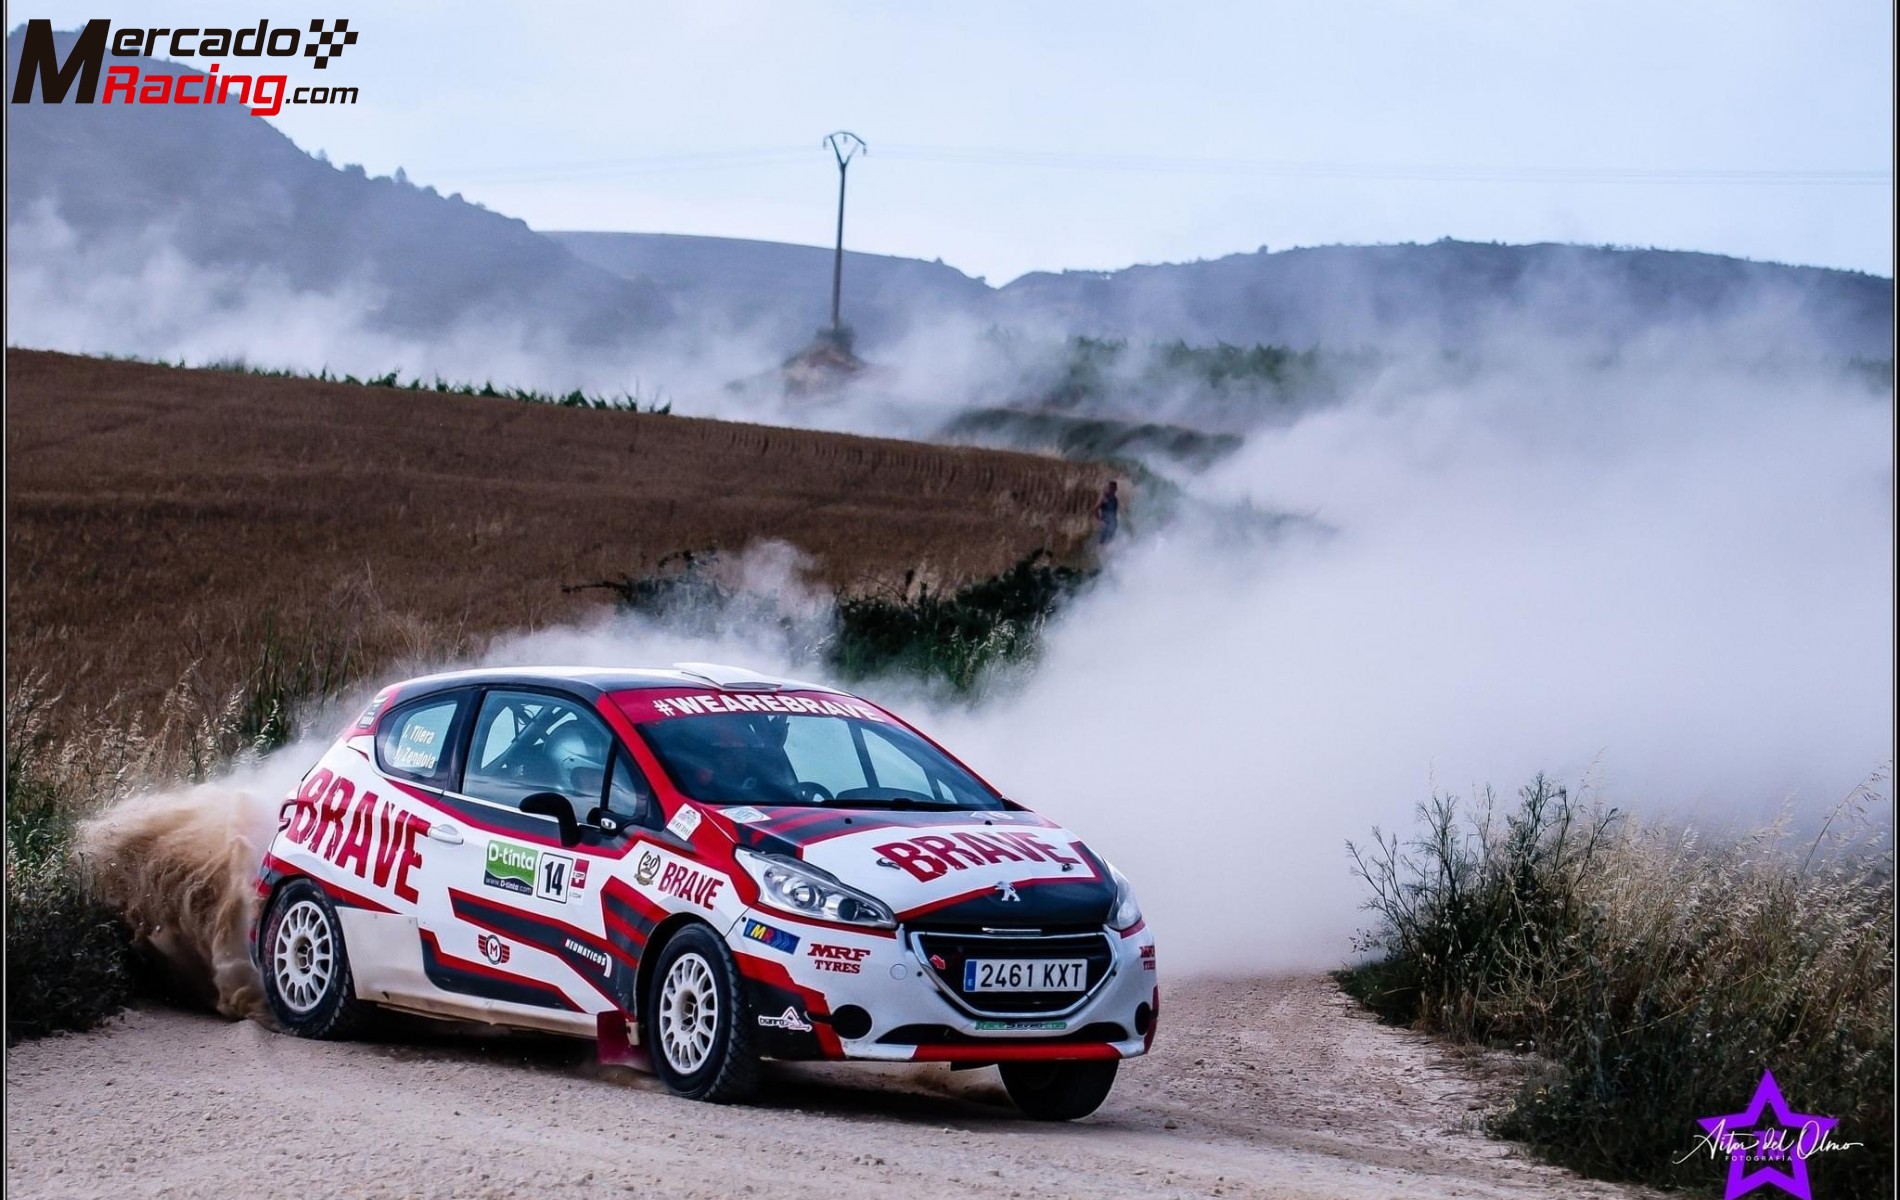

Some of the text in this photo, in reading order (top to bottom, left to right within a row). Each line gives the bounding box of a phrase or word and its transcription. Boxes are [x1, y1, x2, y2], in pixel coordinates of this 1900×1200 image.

[653, 694, 887, 722] #WEAREBRAVE
[285, 767, 431, 905] BRAVE
[488, 843, 536, 871] D-tinta
[872, 832, 1082, 883] BRAVE
[544, 861, 566, 896] 14
[658, 861, 725, 911] BRAVE
[565, 939, 607, 967] NEUMATICOS
[807, 943, 871, 962] MRF
[814, 960, 861, 975] TYRES
[980, 963, 1034, 988] 2461
[1043, 963, 1083, 988] KXT
